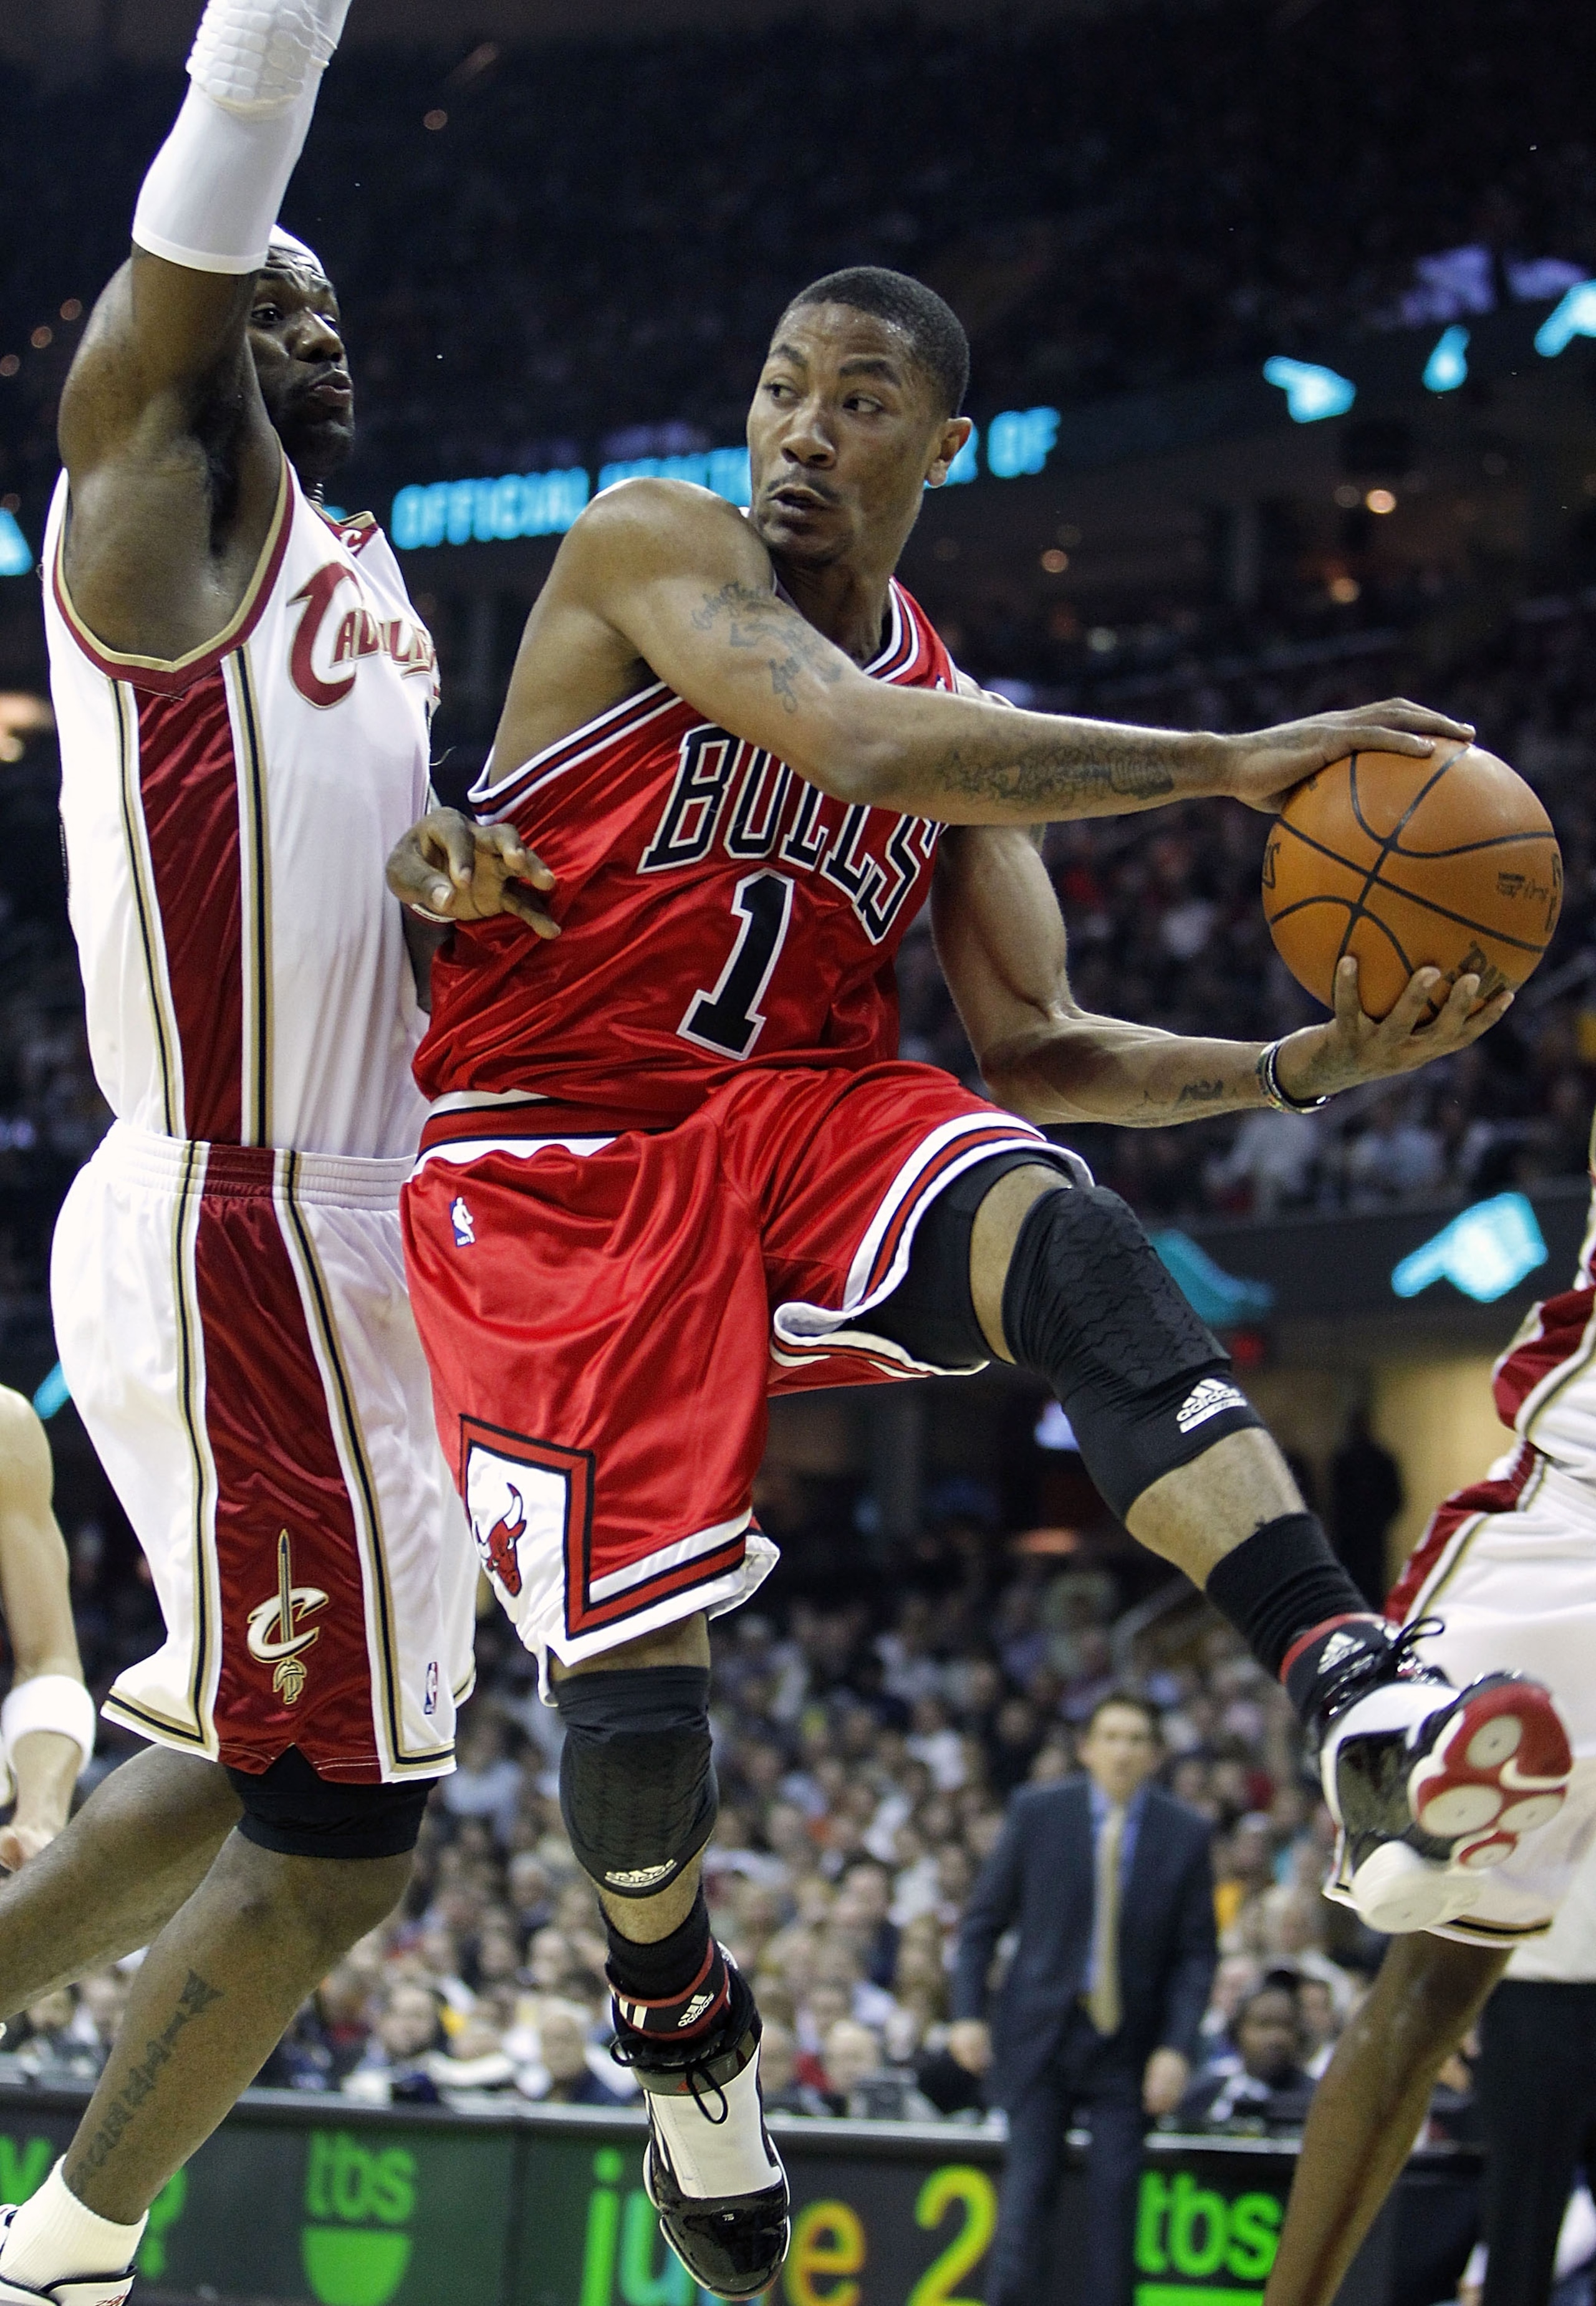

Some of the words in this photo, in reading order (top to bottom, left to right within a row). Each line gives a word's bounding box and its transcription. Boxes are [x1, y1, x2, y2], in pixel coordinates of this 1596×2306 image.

[987, 405, 1060, 479] OF
[636, 723, 948, 946] BULLS
[676, 868, 796, 1061] 1
[677, 1991, 715, 2027] adidas
[304, 2130, 417, 2224] tbs
[580, 2146, 865, 2306] jue
[907, 2164, 998, 2306] 2
[1133, 2169, 1284, 2280] tbs
